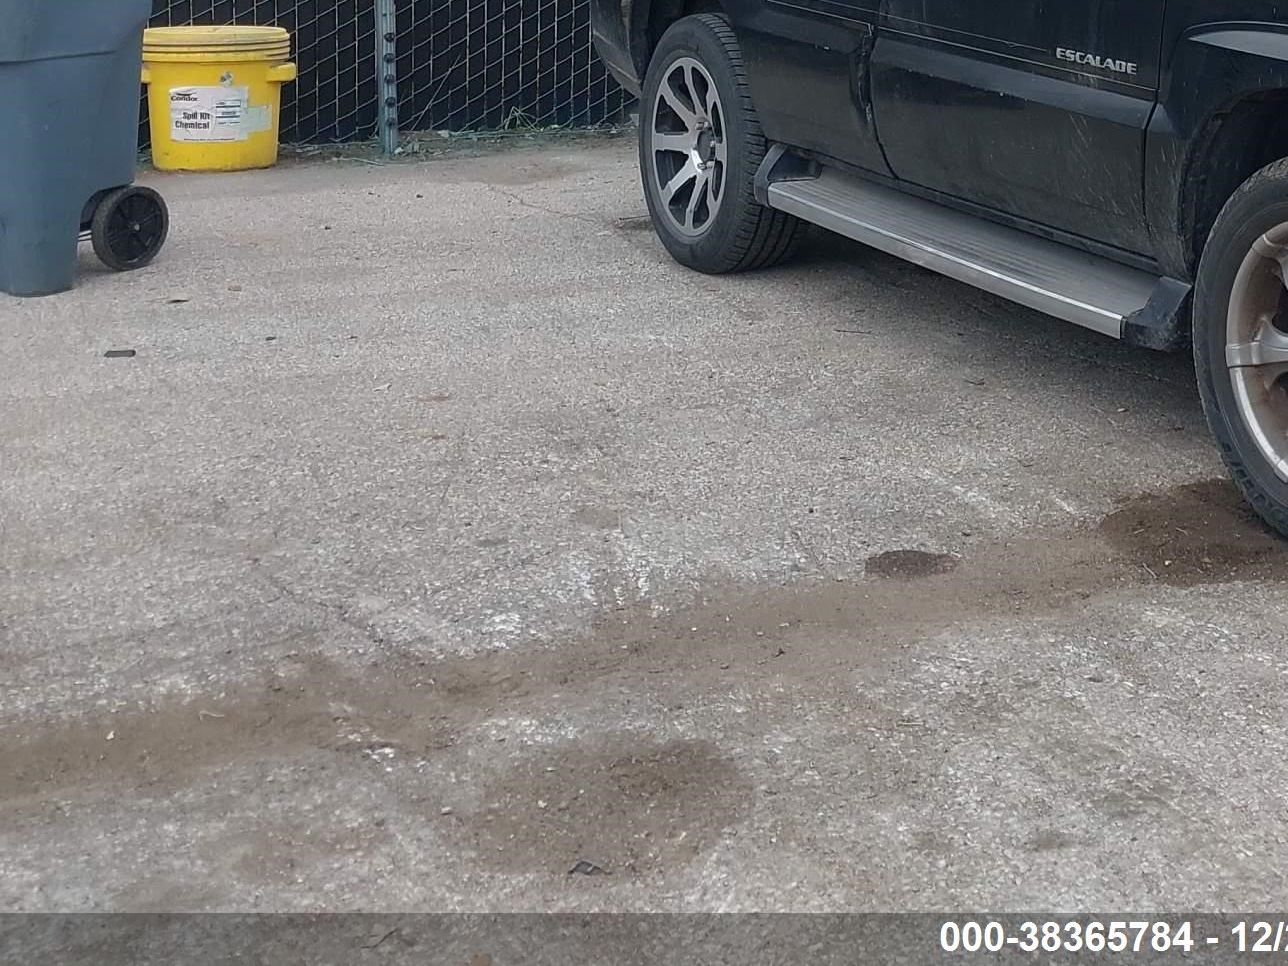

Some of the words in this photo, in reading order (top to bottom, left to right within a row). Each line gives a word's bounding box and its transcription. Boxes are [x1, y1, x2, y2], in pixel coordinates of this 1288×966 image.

[1055, 47, 1138, 75] ESCALADE
[182, 111, 198, 121] Spill
[199, 111, 210, 120] Kit
[175, 120, 210, 130] Chemical
